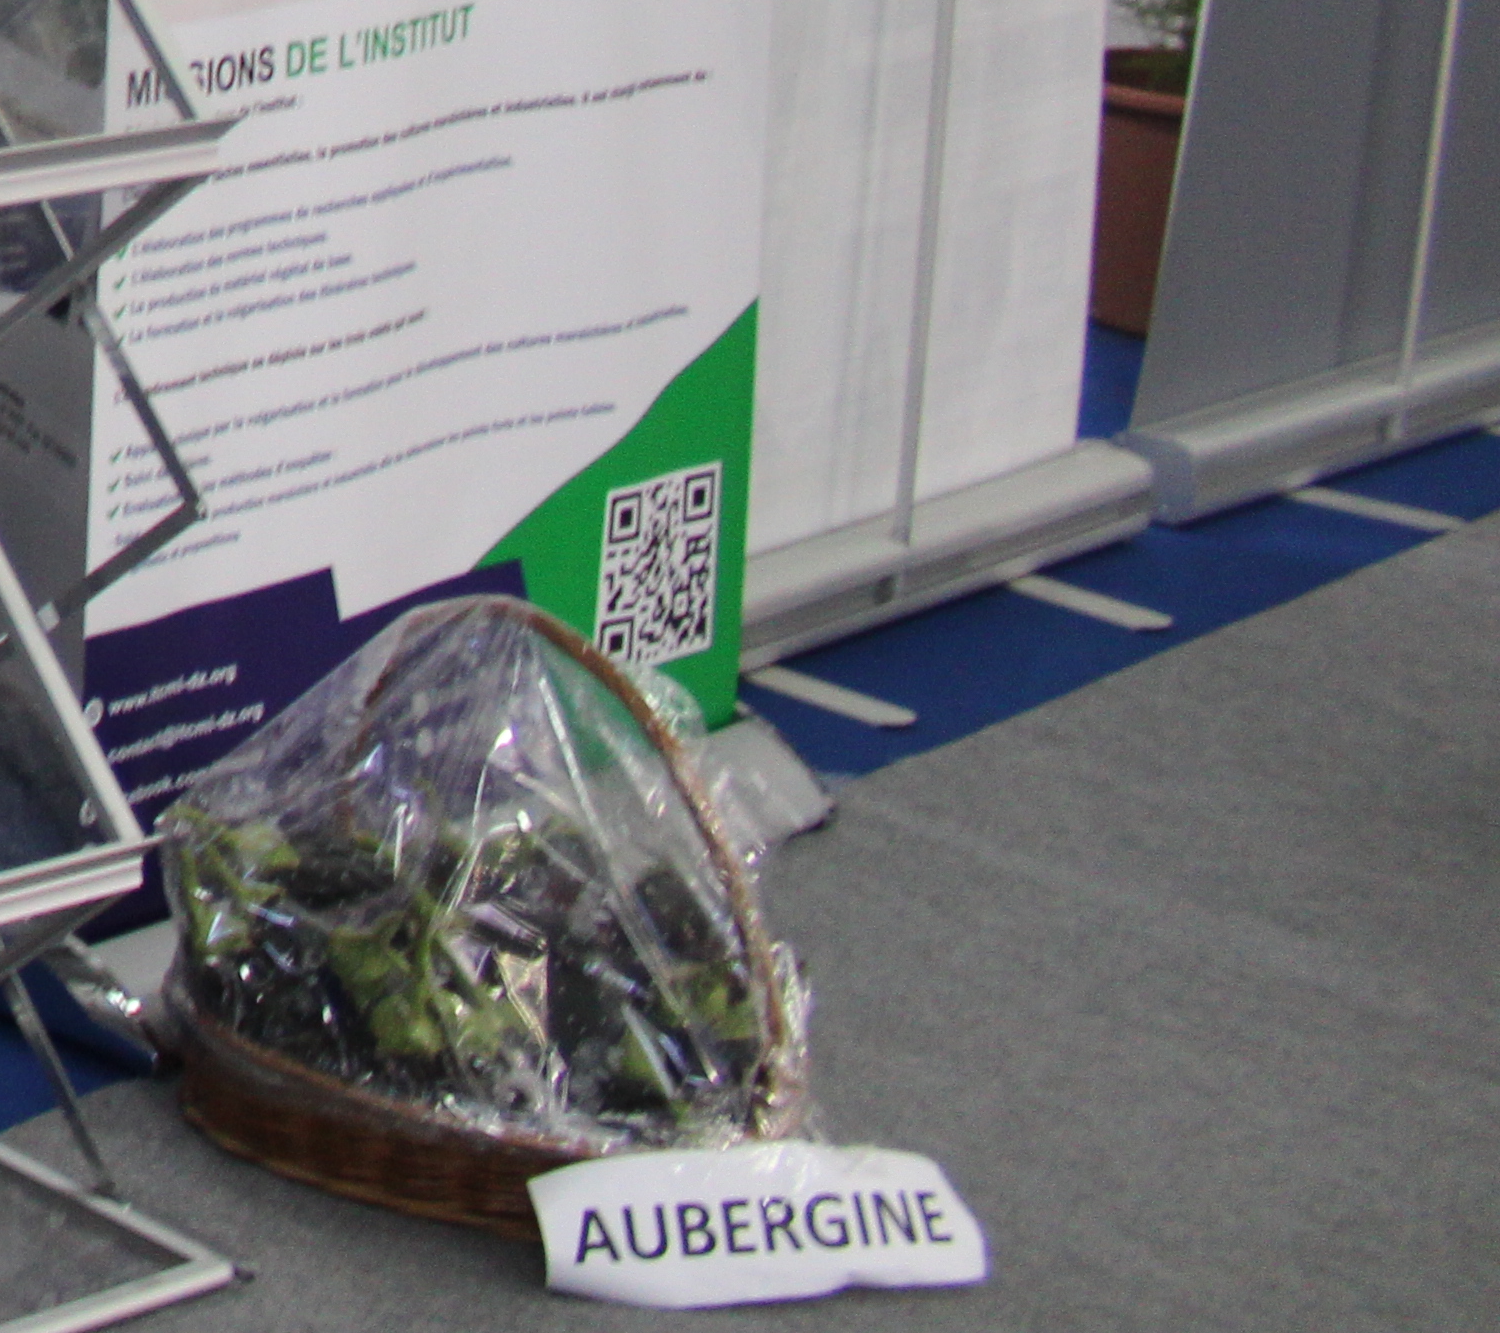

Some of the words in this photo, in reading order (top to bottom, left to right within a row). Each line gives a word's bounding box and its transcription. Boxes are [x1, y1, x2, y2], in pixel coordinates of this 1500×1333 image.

[287, 36, 327, 77] DE
[340, 4, 474, 68] L'INSTITUT
[575, 1190, 953, 1264] AUBERGINE
